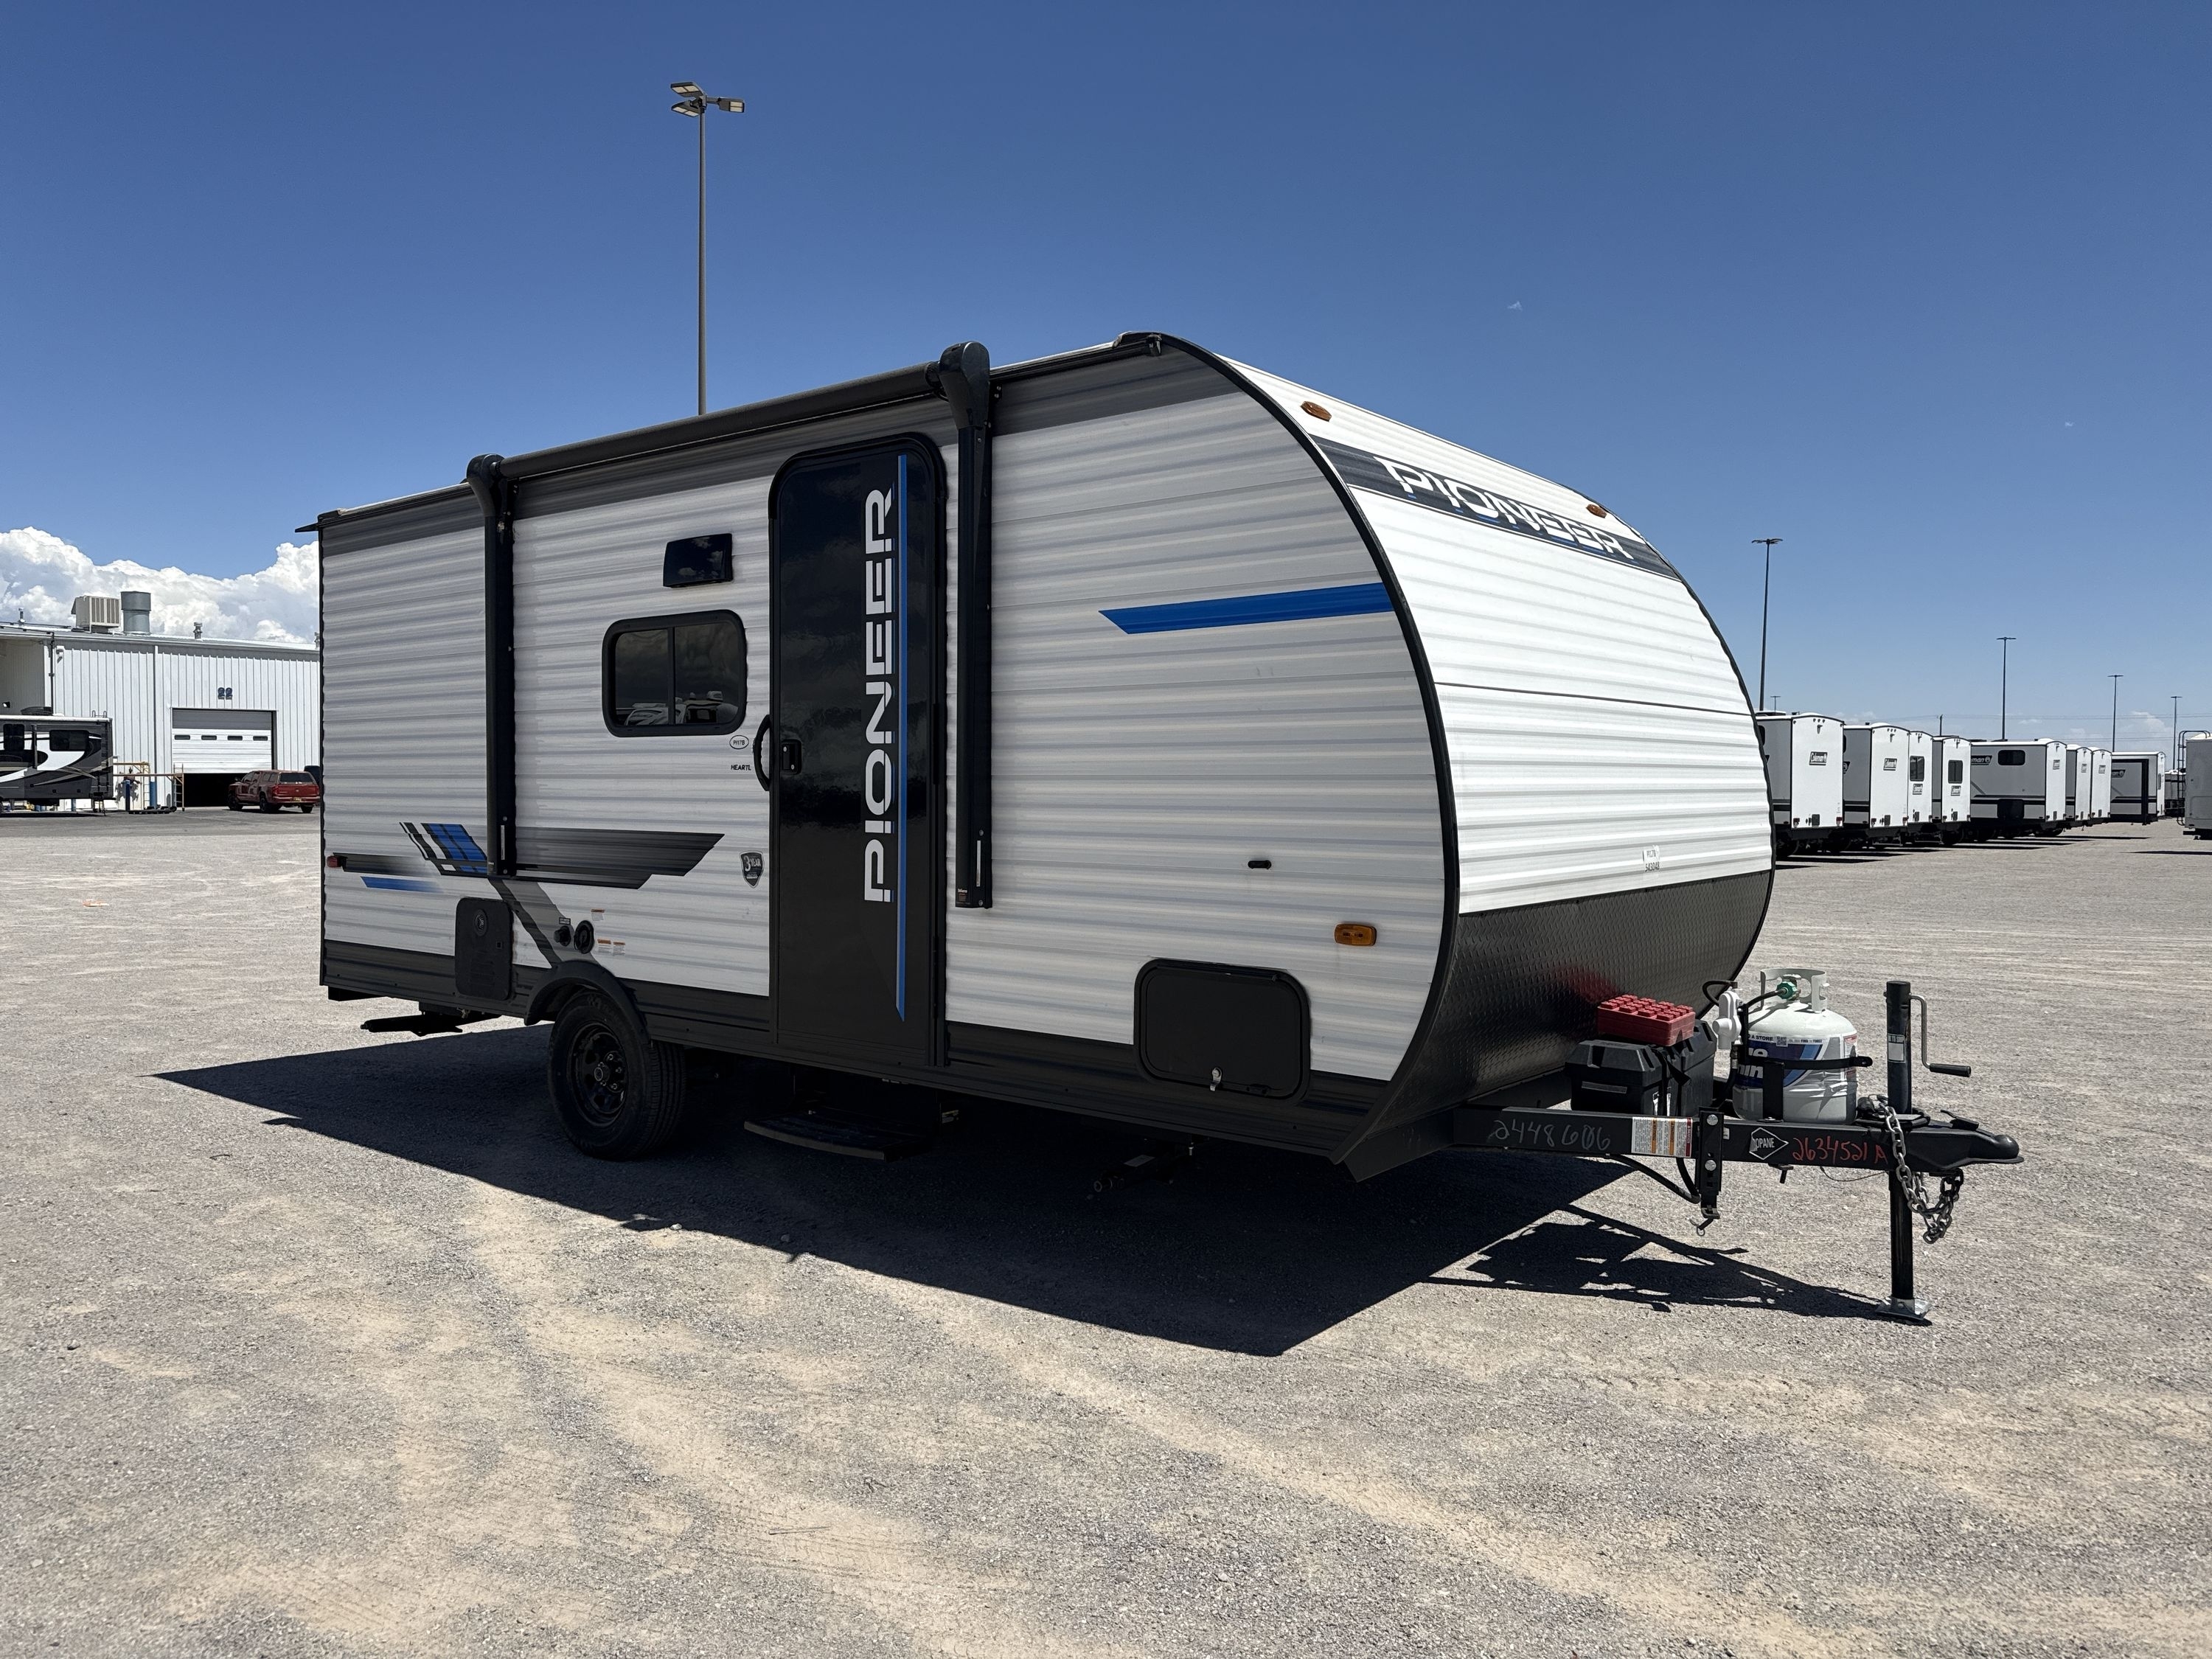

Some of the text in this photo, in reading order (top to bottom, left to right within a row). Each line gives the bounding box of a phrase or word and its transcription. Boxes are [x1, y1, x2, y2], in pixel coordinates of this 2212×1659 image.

[1373, 456, 1634, 560] PIONEER
[864, 488, 892, 902] PIONEER
[744, 855, 751, 872] 3
